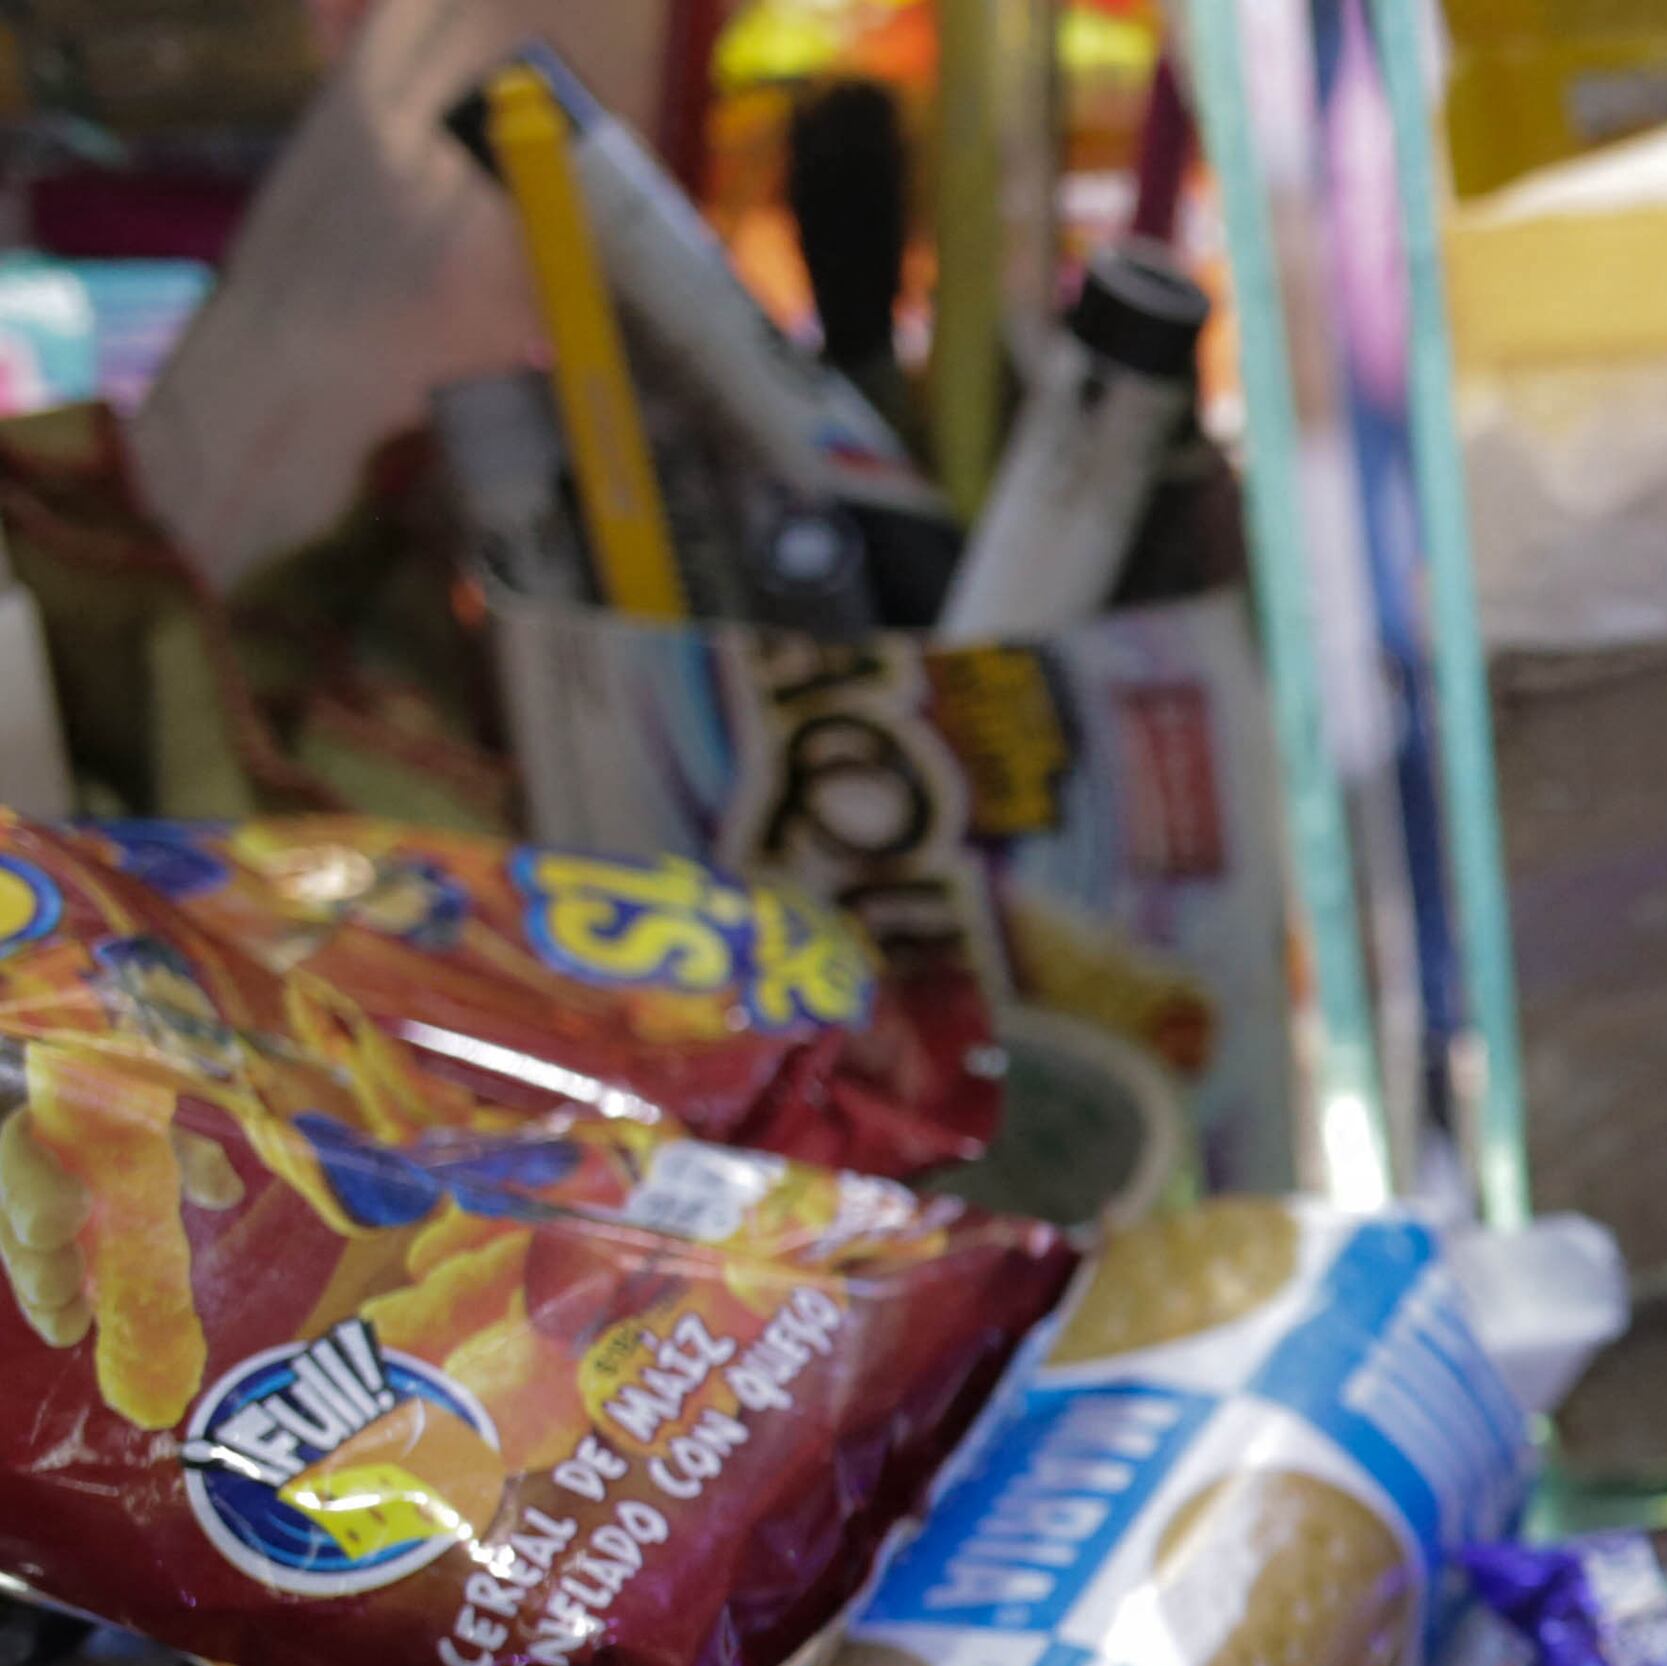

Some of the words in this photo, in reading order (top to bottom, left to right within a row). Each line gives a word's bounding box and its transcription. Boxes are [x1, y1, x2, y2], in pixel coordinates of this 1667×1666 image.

[648, 1409, 750, 1499] CON
[725, 1285, 843, 1411] QUESO
[551, 1434, 629, 1502] DE
